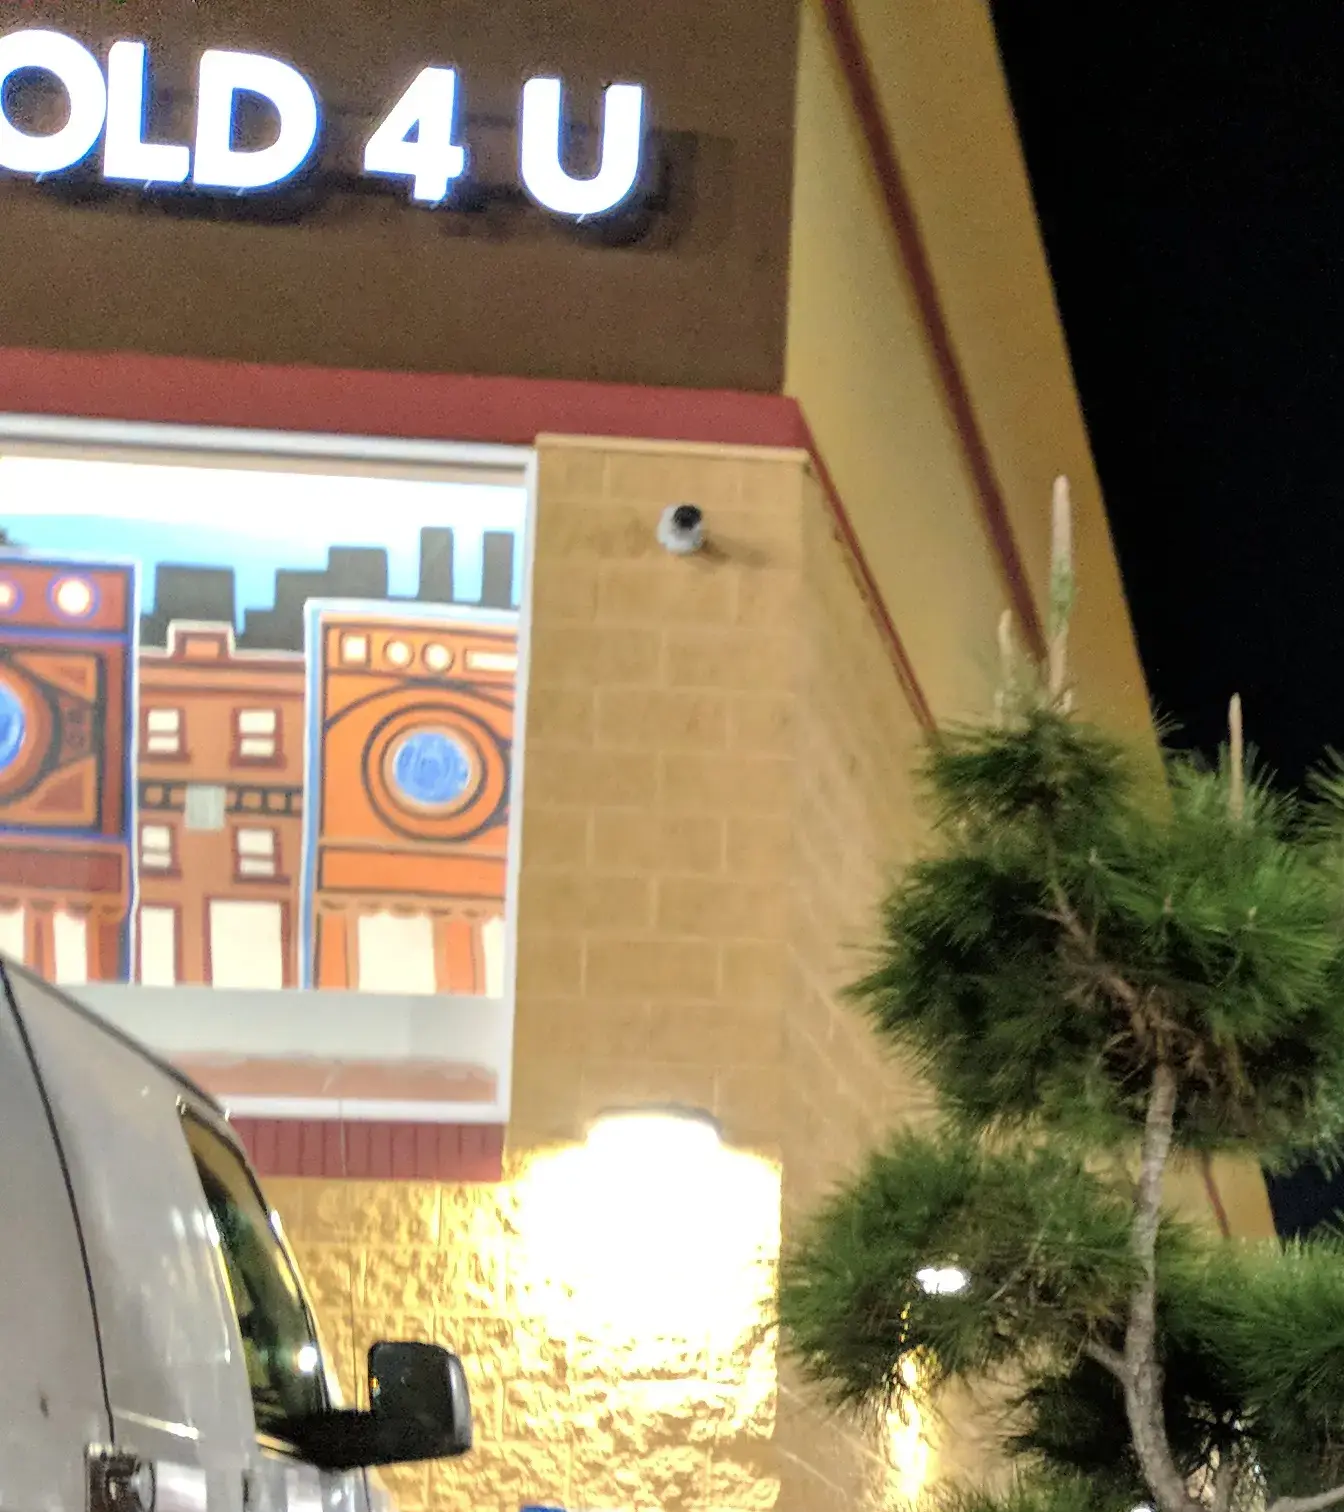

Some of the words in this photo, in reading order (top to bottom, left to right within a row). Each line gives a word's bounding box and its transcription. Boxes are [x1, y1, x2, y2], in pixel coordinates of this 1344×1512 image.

[0, 29, 318, 189] OLD
[363, 66, 467, 204] 4
[520, 76, 644, 216] U
